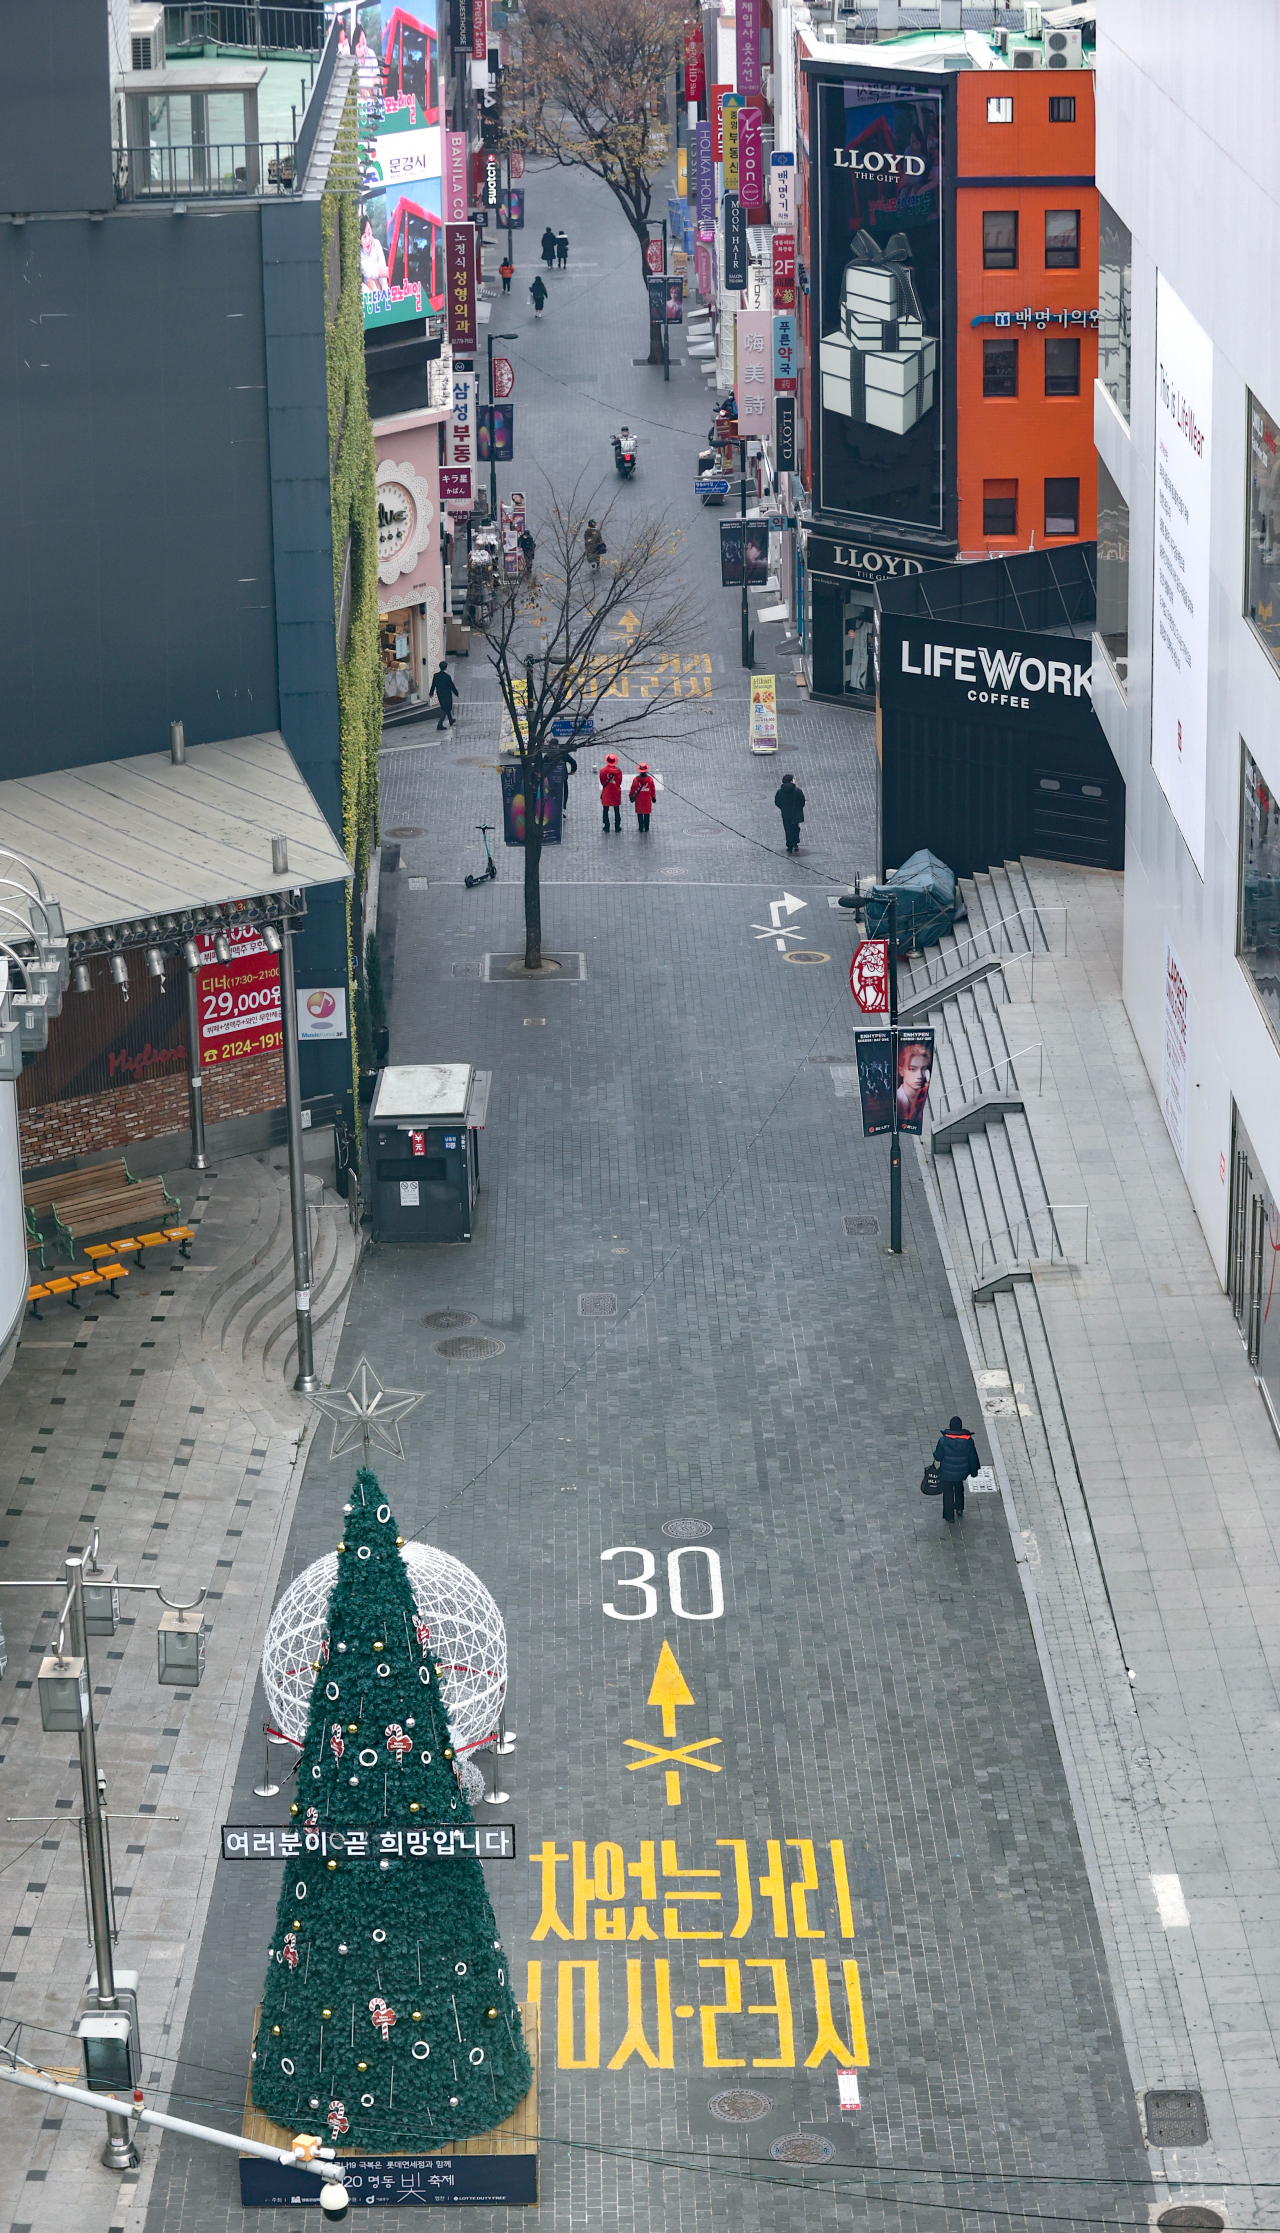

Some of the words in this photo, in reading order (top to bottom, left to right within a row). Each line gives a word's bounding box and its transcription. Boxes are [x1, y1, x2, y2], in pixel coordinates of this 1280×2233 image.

[474, 0, 483, 30] Pretty
[475, 38, 484, 58] skin
[385, 89, 417, 125] 모노레일
[389, 155, 426, 174] 문경시
[451, 137, 463, 193] BANILA
[700, 131, 711, 175] HOLIKA
[833, 148, 926, 177] LLOYD
[486, 162, 497, 205] swatch
[777, 170, 789, 212] 백명기
[854, 172, 875, 181] THE
[876, 174, 900, 184] GIFT
[453, 198, 464, 220] CO
[701, 179, 712, 222] HOLIKA
[731, 201, 740, 233] MOON
[454, 232, 467, 269] 노정식
[732, 236, 740, 268] HAIR
[774, 260, 794, 275] 2F
[391, 279, 422, 313] 모노레일
[453, 271, 471, 334] 성형외과
[777, 321, 793, 375] 푸른약국
[1160, 362, 1170, 409] This
[1171, 381, 1176, 418] is
[1176, 390, 1205, 459] LifeWear
[783, 410, 793, 460] LLOYD
[442, 474, 469, 483] キラ星
[772, 517, 786, 530] 약
[833, 546, 924, 576] LLOYD
[856, 570, 874, 579] THE
[901, 640, 1093, 698] LIFEWORK
[754, 704, 764, 714] 足
[967, 690, 1030, 710] COFFEE
[600, 1546, 725, 1621] 30
[226, 1831, 327, 1856] 여러분이
[343, 1831, 369, 1856] 곧
[379, 1830, 509, 1856] 희망입니다
[529, 1838, 855, 1941] 차없는거리
[358, 2161, 382, 2170] 극복은
[386, 2160, 434, 2169] 롯데면세점과
[435, 2160, 452, 2169] 함께
[341, 2175, 363, 2188] 20
[367, 2175, 395, 2189] 명동
[396, 2172, 426, 2203] 빛
[427, 2174, 455, 2188] 축제
